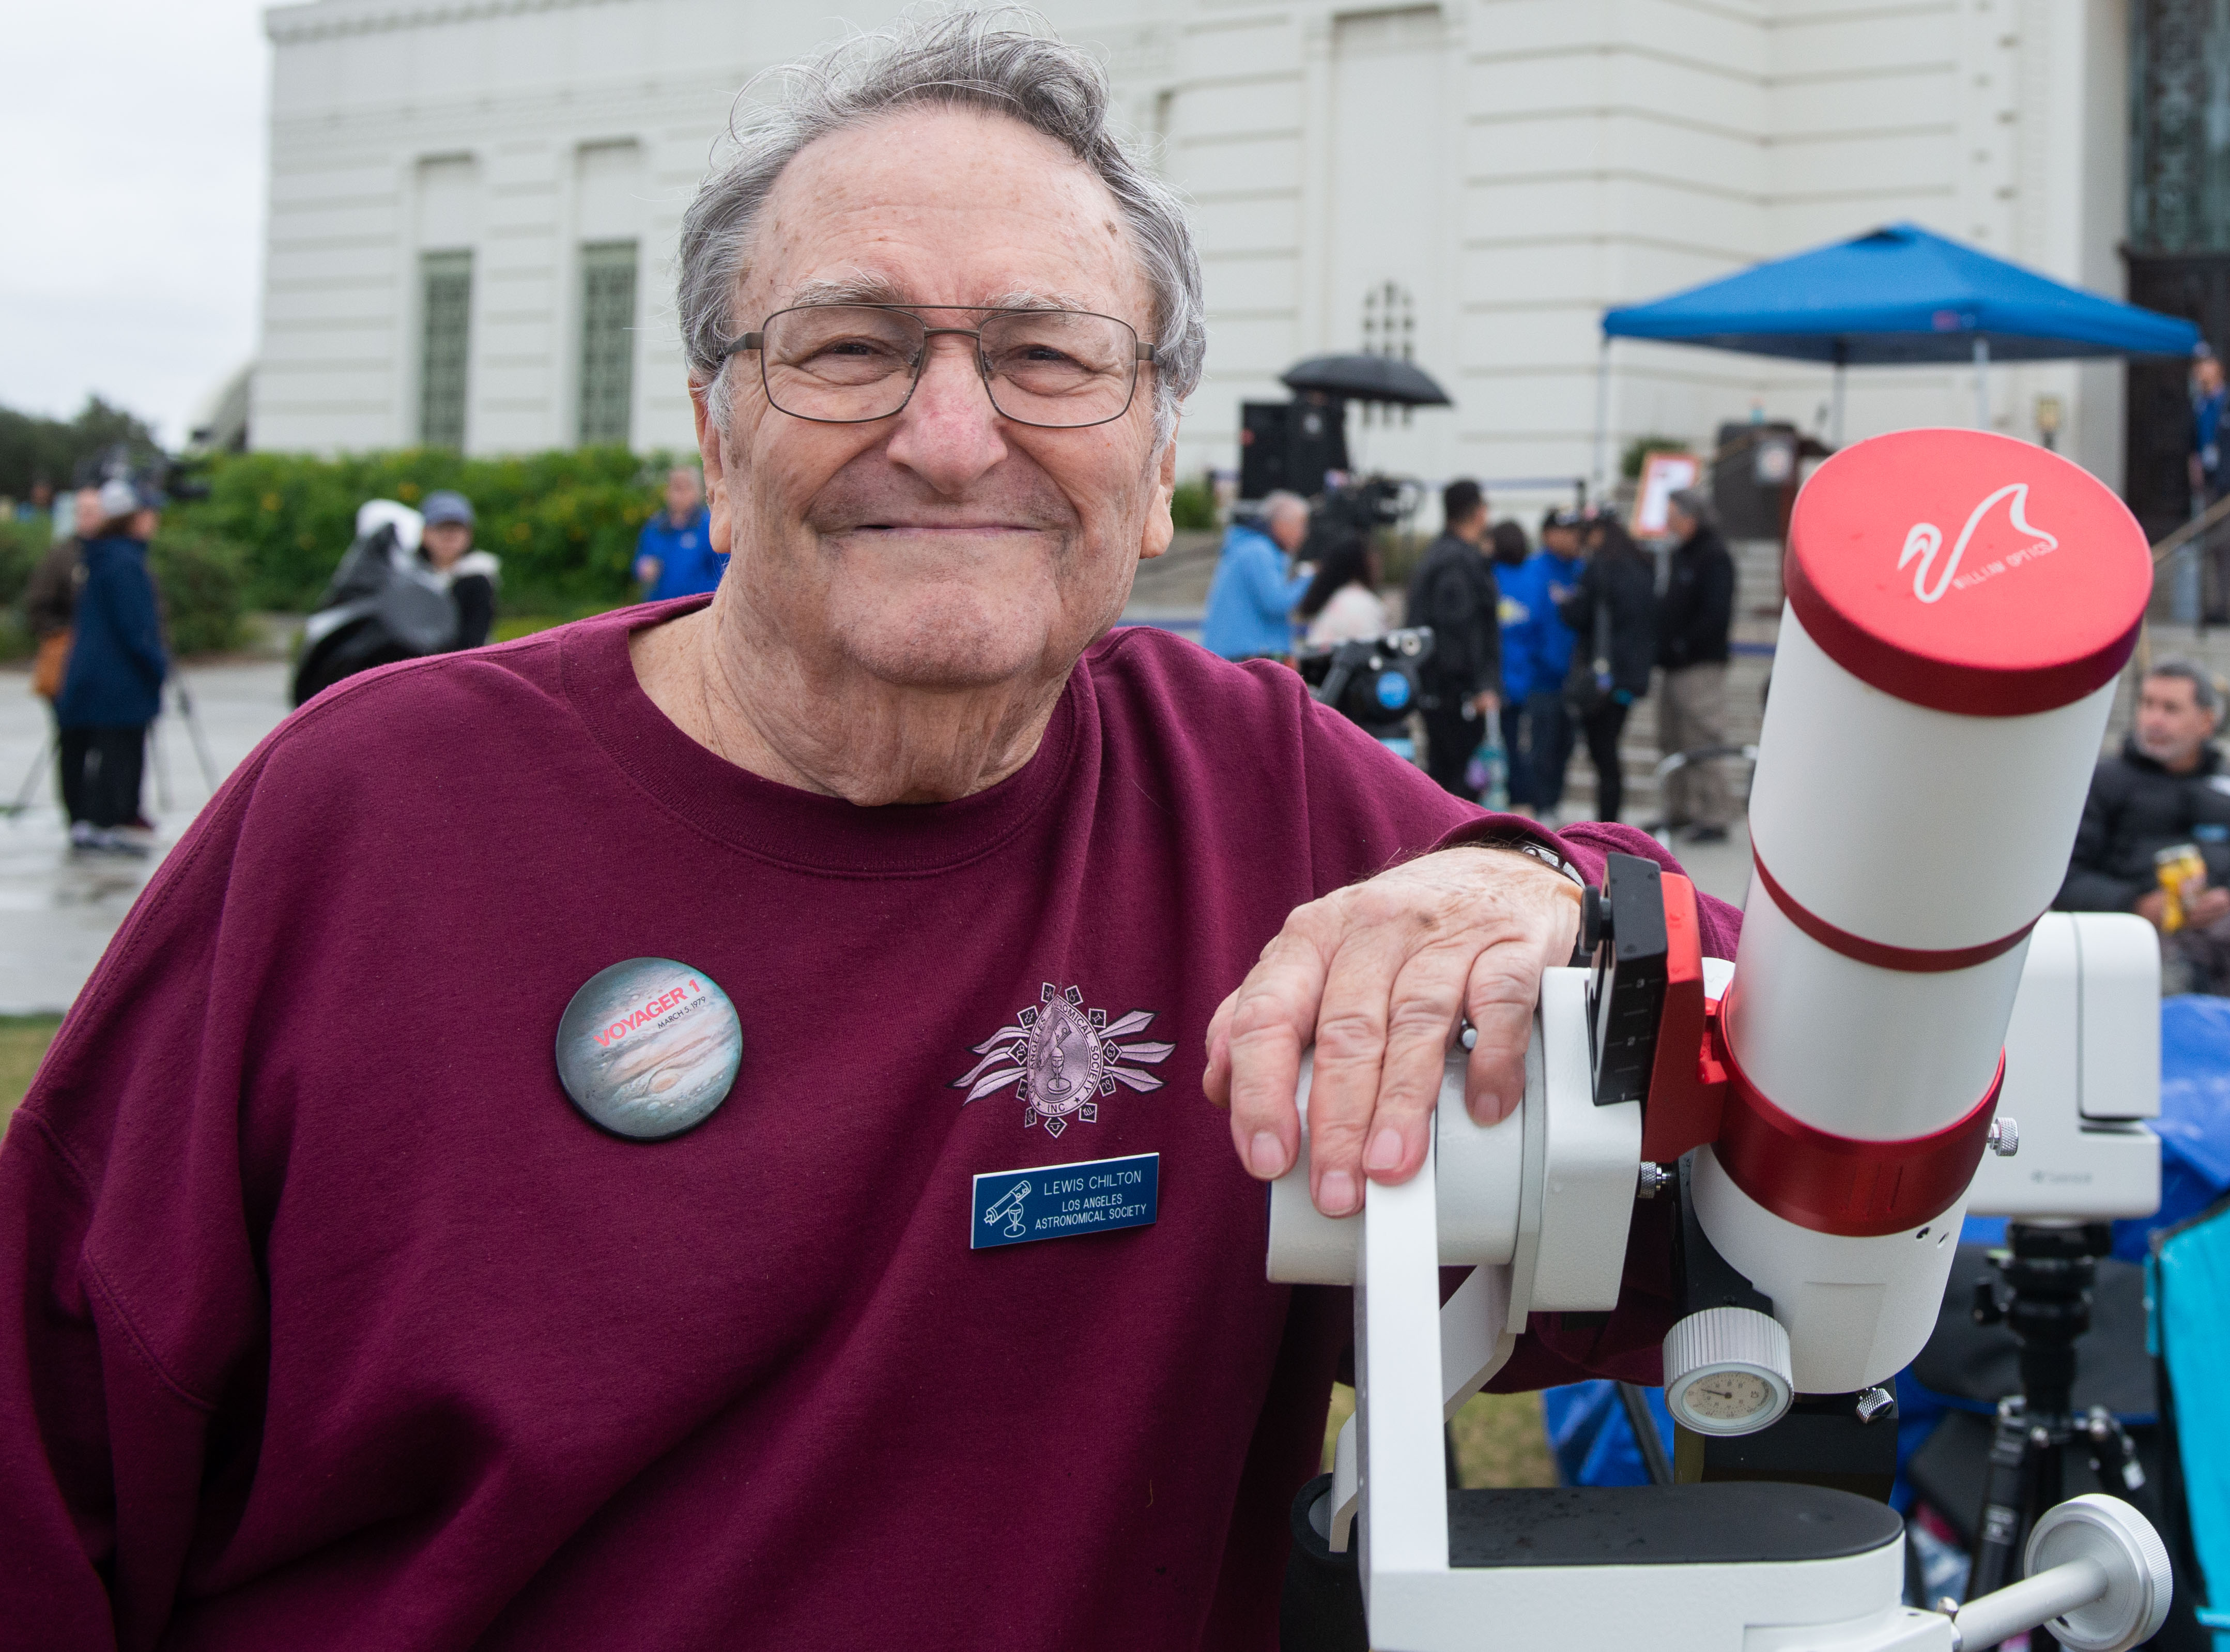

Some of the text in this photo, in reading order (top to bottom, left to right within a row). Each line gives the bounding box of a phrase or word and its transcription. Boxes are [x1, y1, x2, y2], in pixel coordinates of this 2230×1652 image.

[1636, 978, 1645, 989] 3
[593, 979, 701, 1047] VOYAGER 1
[657, 1010, 684, 1029] MARCH
[690, 996, 705, 1008] 1979
[1030, 1016, 1046, 1070] ANGELES
[1083, 1045, 1100, 1093] SOCIETY
[1047, 1103, 1066, 1113] INC
[1044, 1170, 1142, 1196] LEWIS CHILTON
[1062, 1194, 1122, 1212] LOS ANGELES
[1035, 1203, 1147, 1230] ASTRONOMICAL SOCIETY
